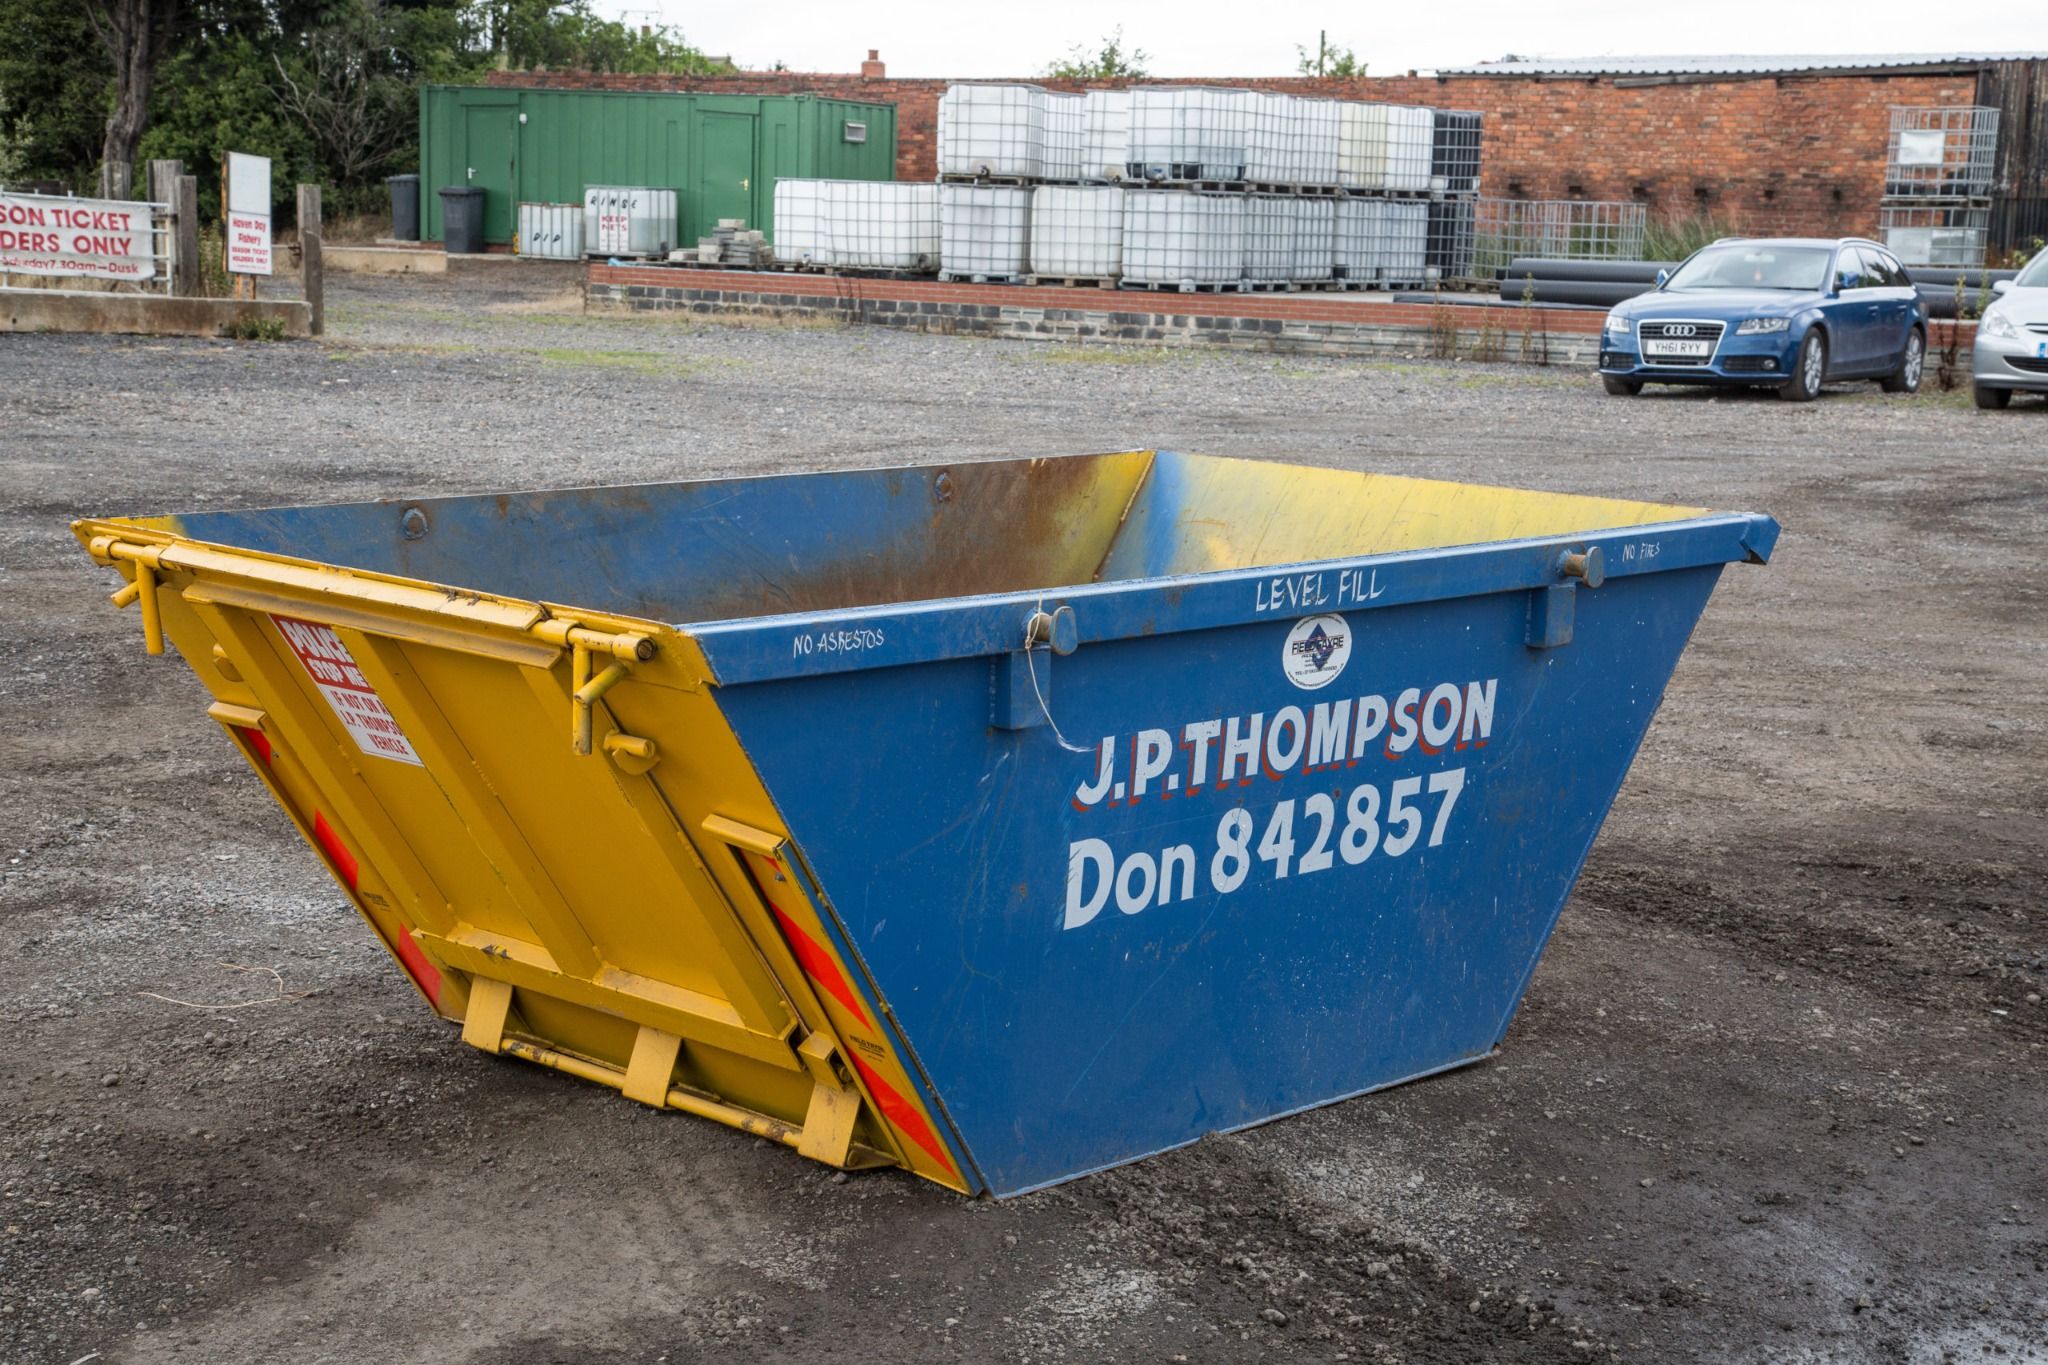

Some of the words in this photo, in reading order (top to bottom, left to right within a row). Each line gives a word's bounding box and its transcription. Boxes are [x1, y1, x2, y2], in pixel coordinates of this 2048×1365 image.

[590, 196, 638, 209] RINSE
[50, 209, 131, 232] TICKET
[601, 223, 628, 232] NES
[0, 230, 60, 253] DERS
[72, 235, 132, 256] ONLY
[533, 232, 561, 243] DIP
[1655, 341, 1678, 353] YH61
[1680, 341, 1702, 353] RYY
[1622, 543, 1636, 562] NO
[1640, 541, 1661, 560] FIRES
[1255, 573, 1330, 612] LEVEL
[1337, 568, 1387, 606] FILL
[279, 619, 355, 664] POLICE
[793, 633, 813, 659] NO
[816, 628, 885, 656] ASBESTOS
[306, 657, 346, 683] STOP
[340, 665, 370, 688] ME
[330, 690, 344, 706] IF
[341, 692, 365, 711] NOT
[361, 696, 381, 714] ON
[376, 699, 390, 716] A
[367, 733, 409, 755] VEHICLE
[1063, 837, 1197, 931] Don
[1209, 767, 1467, 895] 842857
